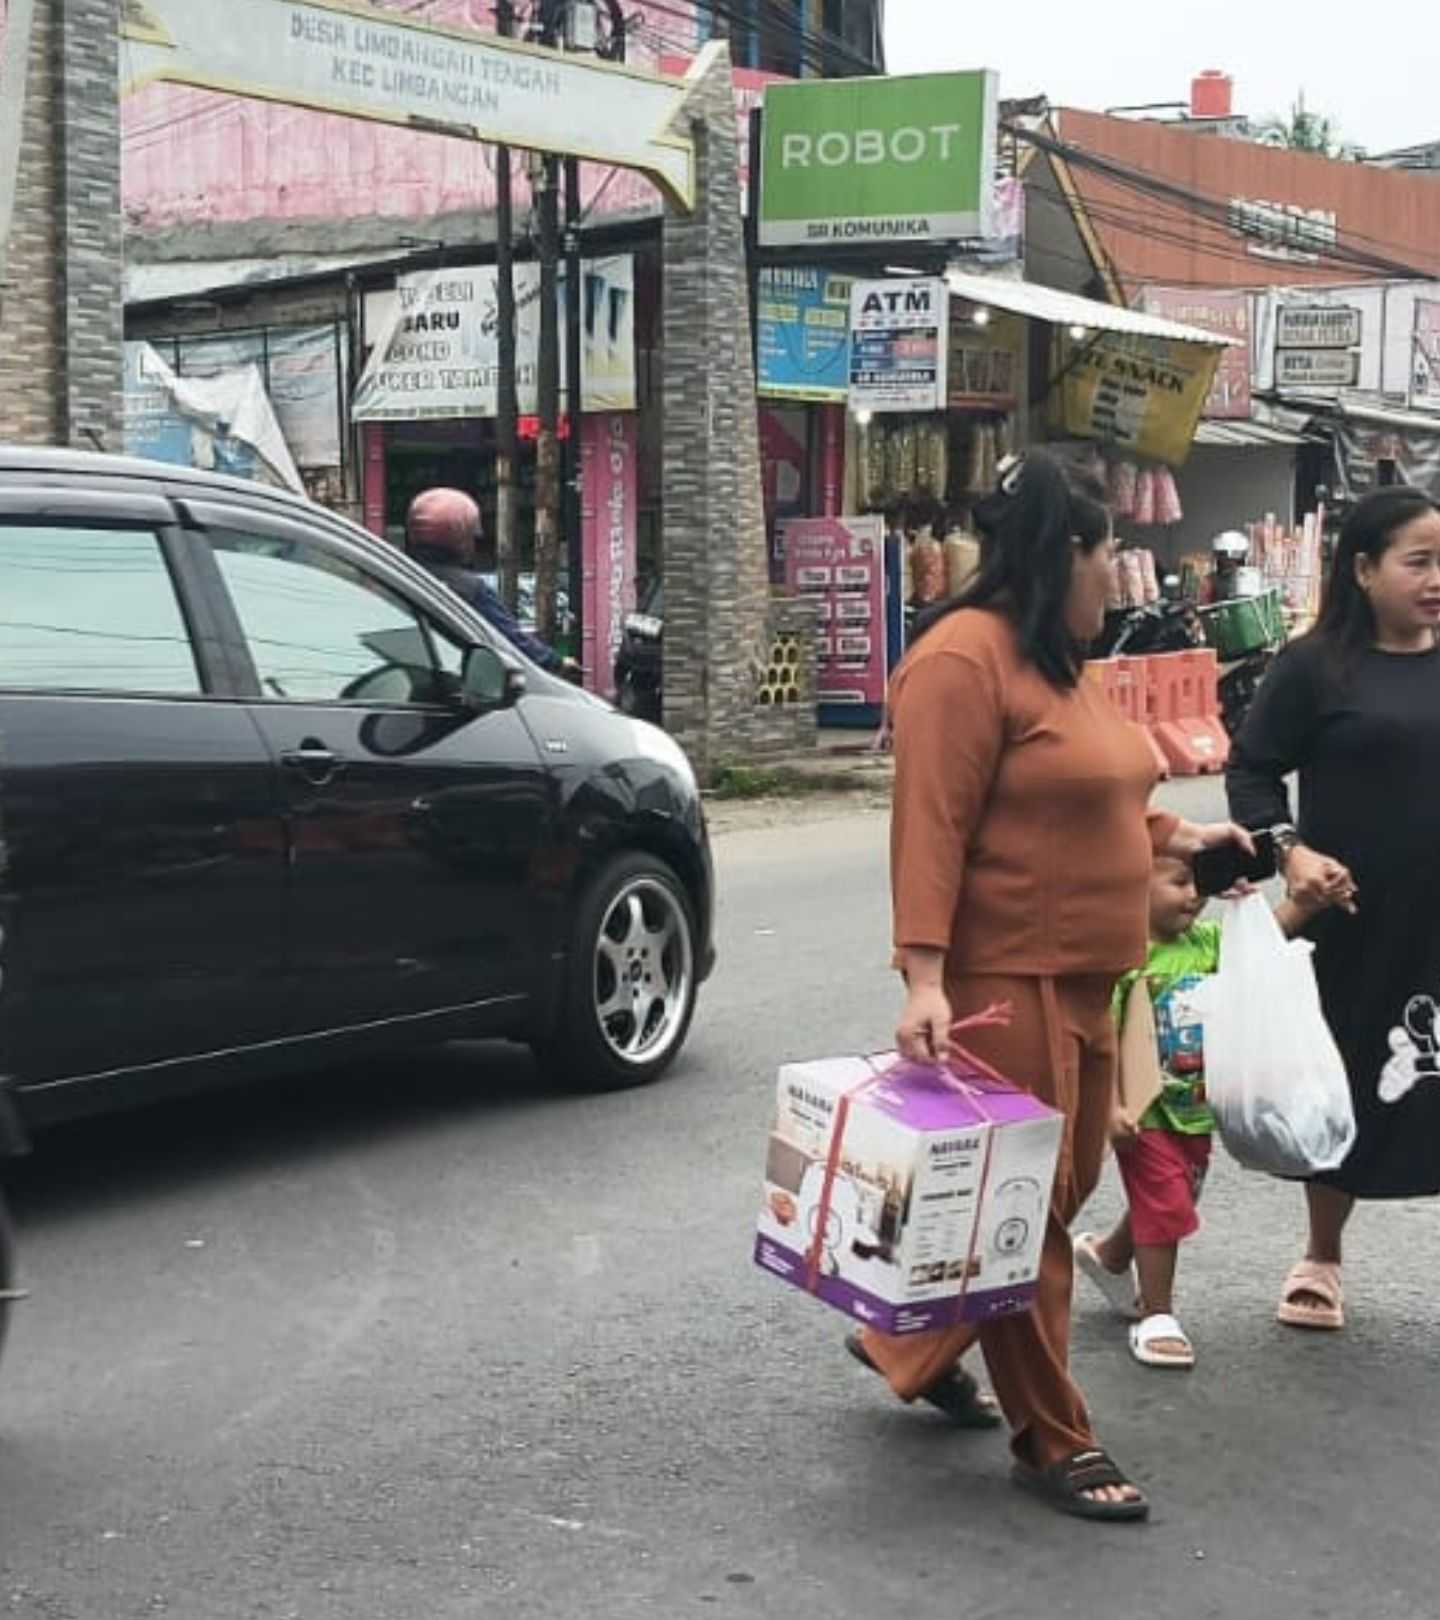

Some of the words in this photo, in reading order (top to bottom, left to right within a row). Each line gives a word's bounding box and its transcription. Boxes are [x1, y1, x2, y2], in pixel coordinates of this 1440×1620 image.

[291, 13, 346, 45] DESA
[331, 56, 374, 86] KEC
[782, 124, 960, 169] ROBOT
[832, 219, 930, 237] KOMUNIKA
[862, 291, 931, 312] ATM
